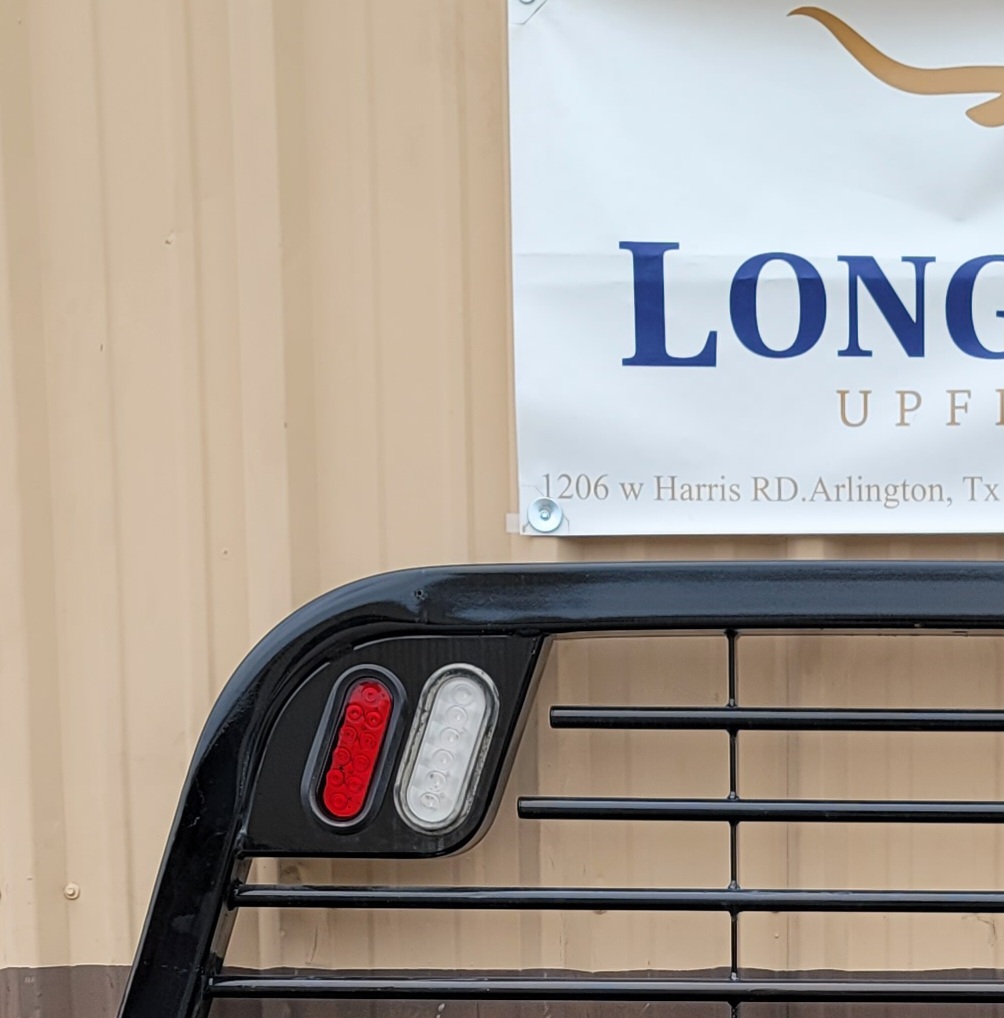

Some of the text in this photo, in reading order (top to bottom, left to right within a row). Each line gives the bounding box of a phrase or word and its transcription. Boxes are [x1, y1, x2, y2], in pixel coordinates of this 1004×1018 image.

[543, 473, 609, 500] 1206
[619, 482, 644, 501] w
[654, 475, 742, 502] Harris
[962, 476, 1001, 502] Tx
